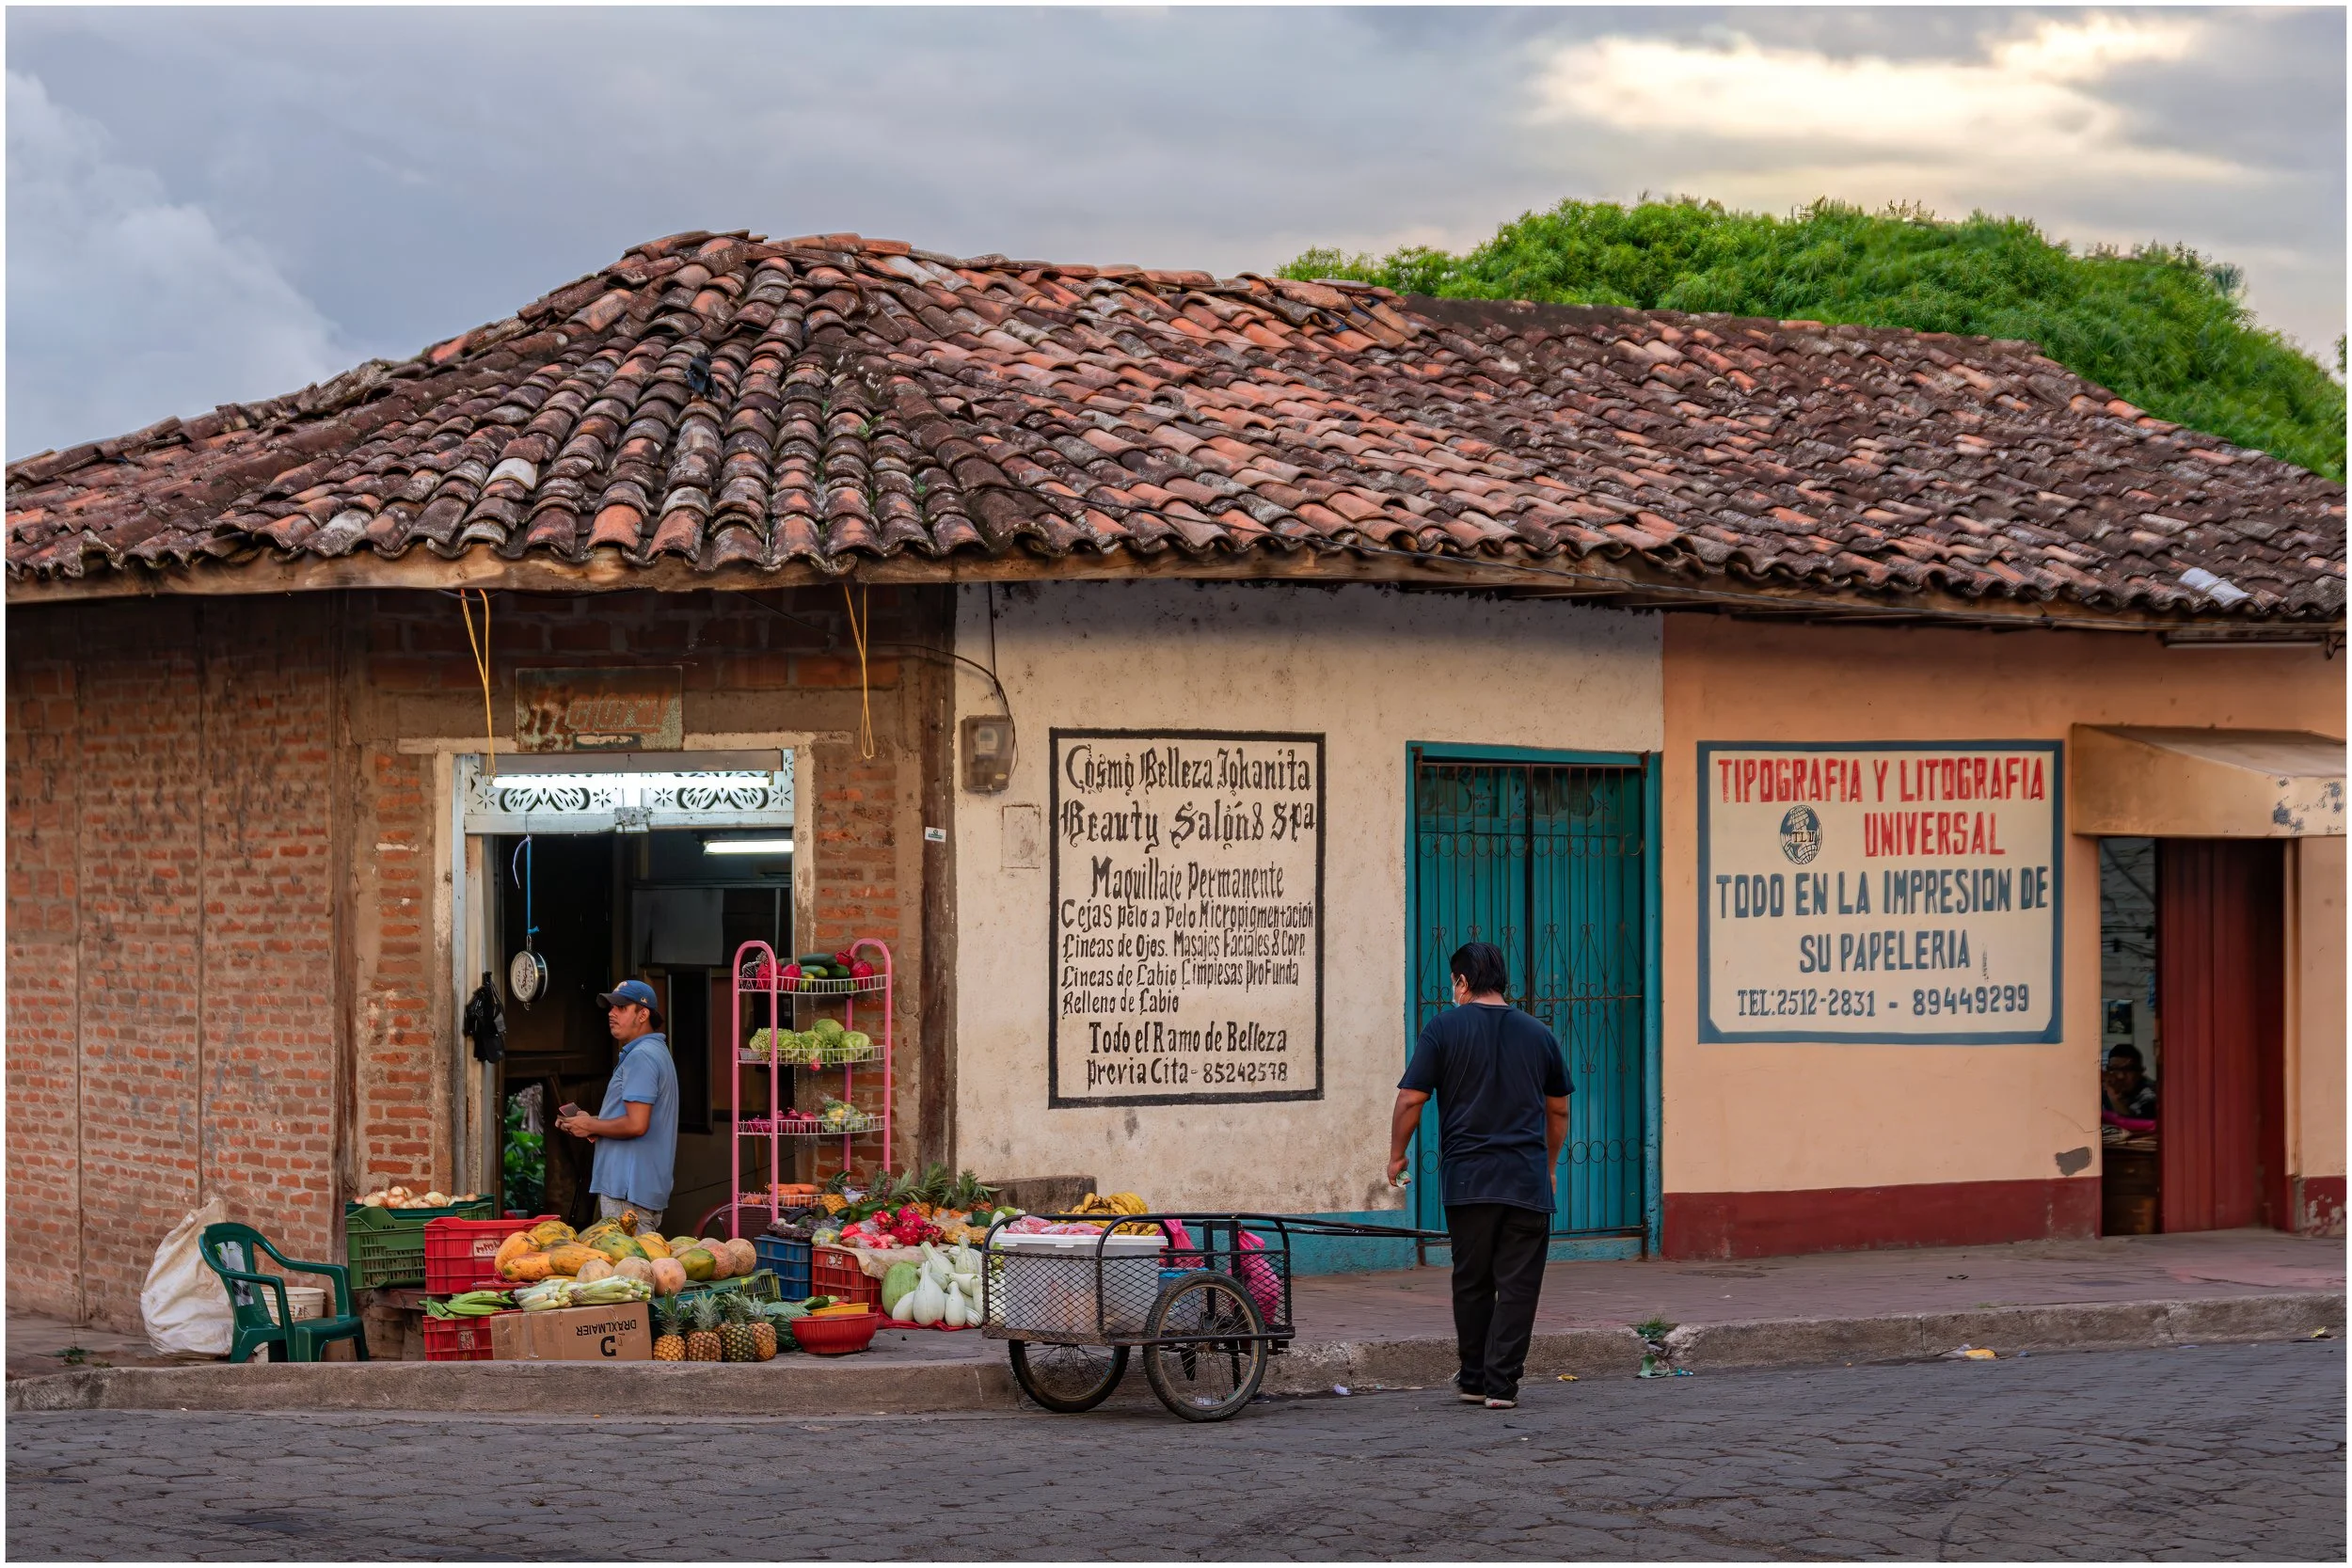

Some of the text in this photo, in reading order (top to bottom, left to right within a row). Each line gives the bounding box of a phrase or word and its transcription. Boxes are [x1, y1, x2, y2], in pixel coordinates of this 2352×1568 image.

[1065, 744, 1135, 796] Cosmo
[1139, 746, 1214, 795] Belleza
[1717, 756, 2045, 803] TIPOGRAFIA Y LITOGRAFIA
[1060, 799, 1160, 854] Beauty
[1270, 801, 1316, 843] Spa
[1864, 812, 2006, 857] UNIVERSAL
[1187, 861, 1284, 900] Permanente
[1716, 865, 2049, 919] TODO EN LA IMPRESION DE
[1061, 898, 1112, 933] Cejas
[1151, 910, 1160, 927] a
[1199, 899, 1313, 933] Micropigmentación
[1062, 933, 1114, 963] Lineas
[1118, 932, 1133, 958] de
[1173, 929, 1220, 961] Masajes
[1223, 927, 1270, 958] Faciales
[1799, 928, 1972, 974] SU PAPELERIA
[1060, 965, 1114, 990] Lineas
[1117, 963, 1134, 988] de
[1136, 960, 1177, 987] Labio
[1061, 988, 1180, 1020] Relleno de Labio
[1913, 983, 2030, 1017] 89449299
[1089, 1021, 1288, 1053] Todo el Ramo de Belleza
[1202, 1061, 1289, 1084] 85242578
